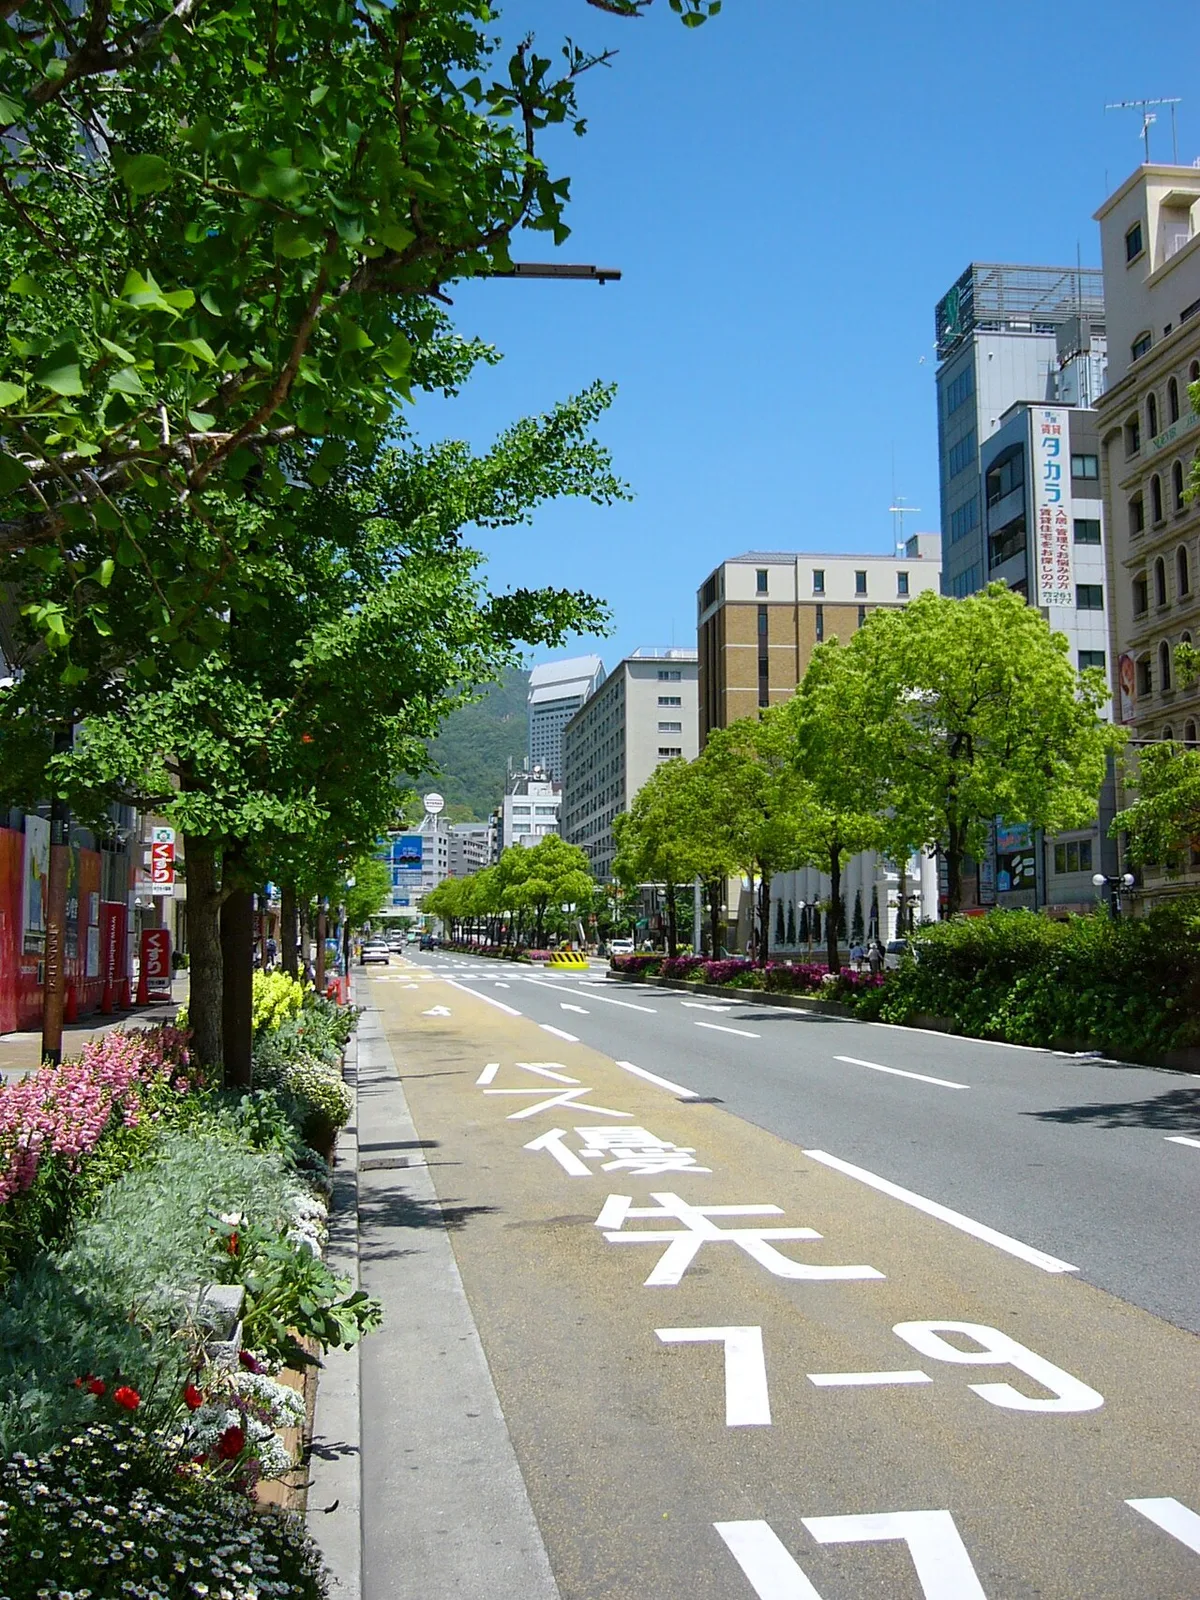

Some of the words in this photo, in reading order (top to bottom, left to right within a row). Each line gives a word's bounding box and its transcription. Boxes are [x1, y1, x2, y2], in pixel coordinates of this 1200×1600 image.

[1042, 437, 1061, 503] タカラ
[1040, 508, 1053, 590] 賃貸住宅をお探しの方
[154, 844, 172, 882] くすり
[146, 933, 164, 974] くすり
[654, 1320, 1105, 1427] 7-9
